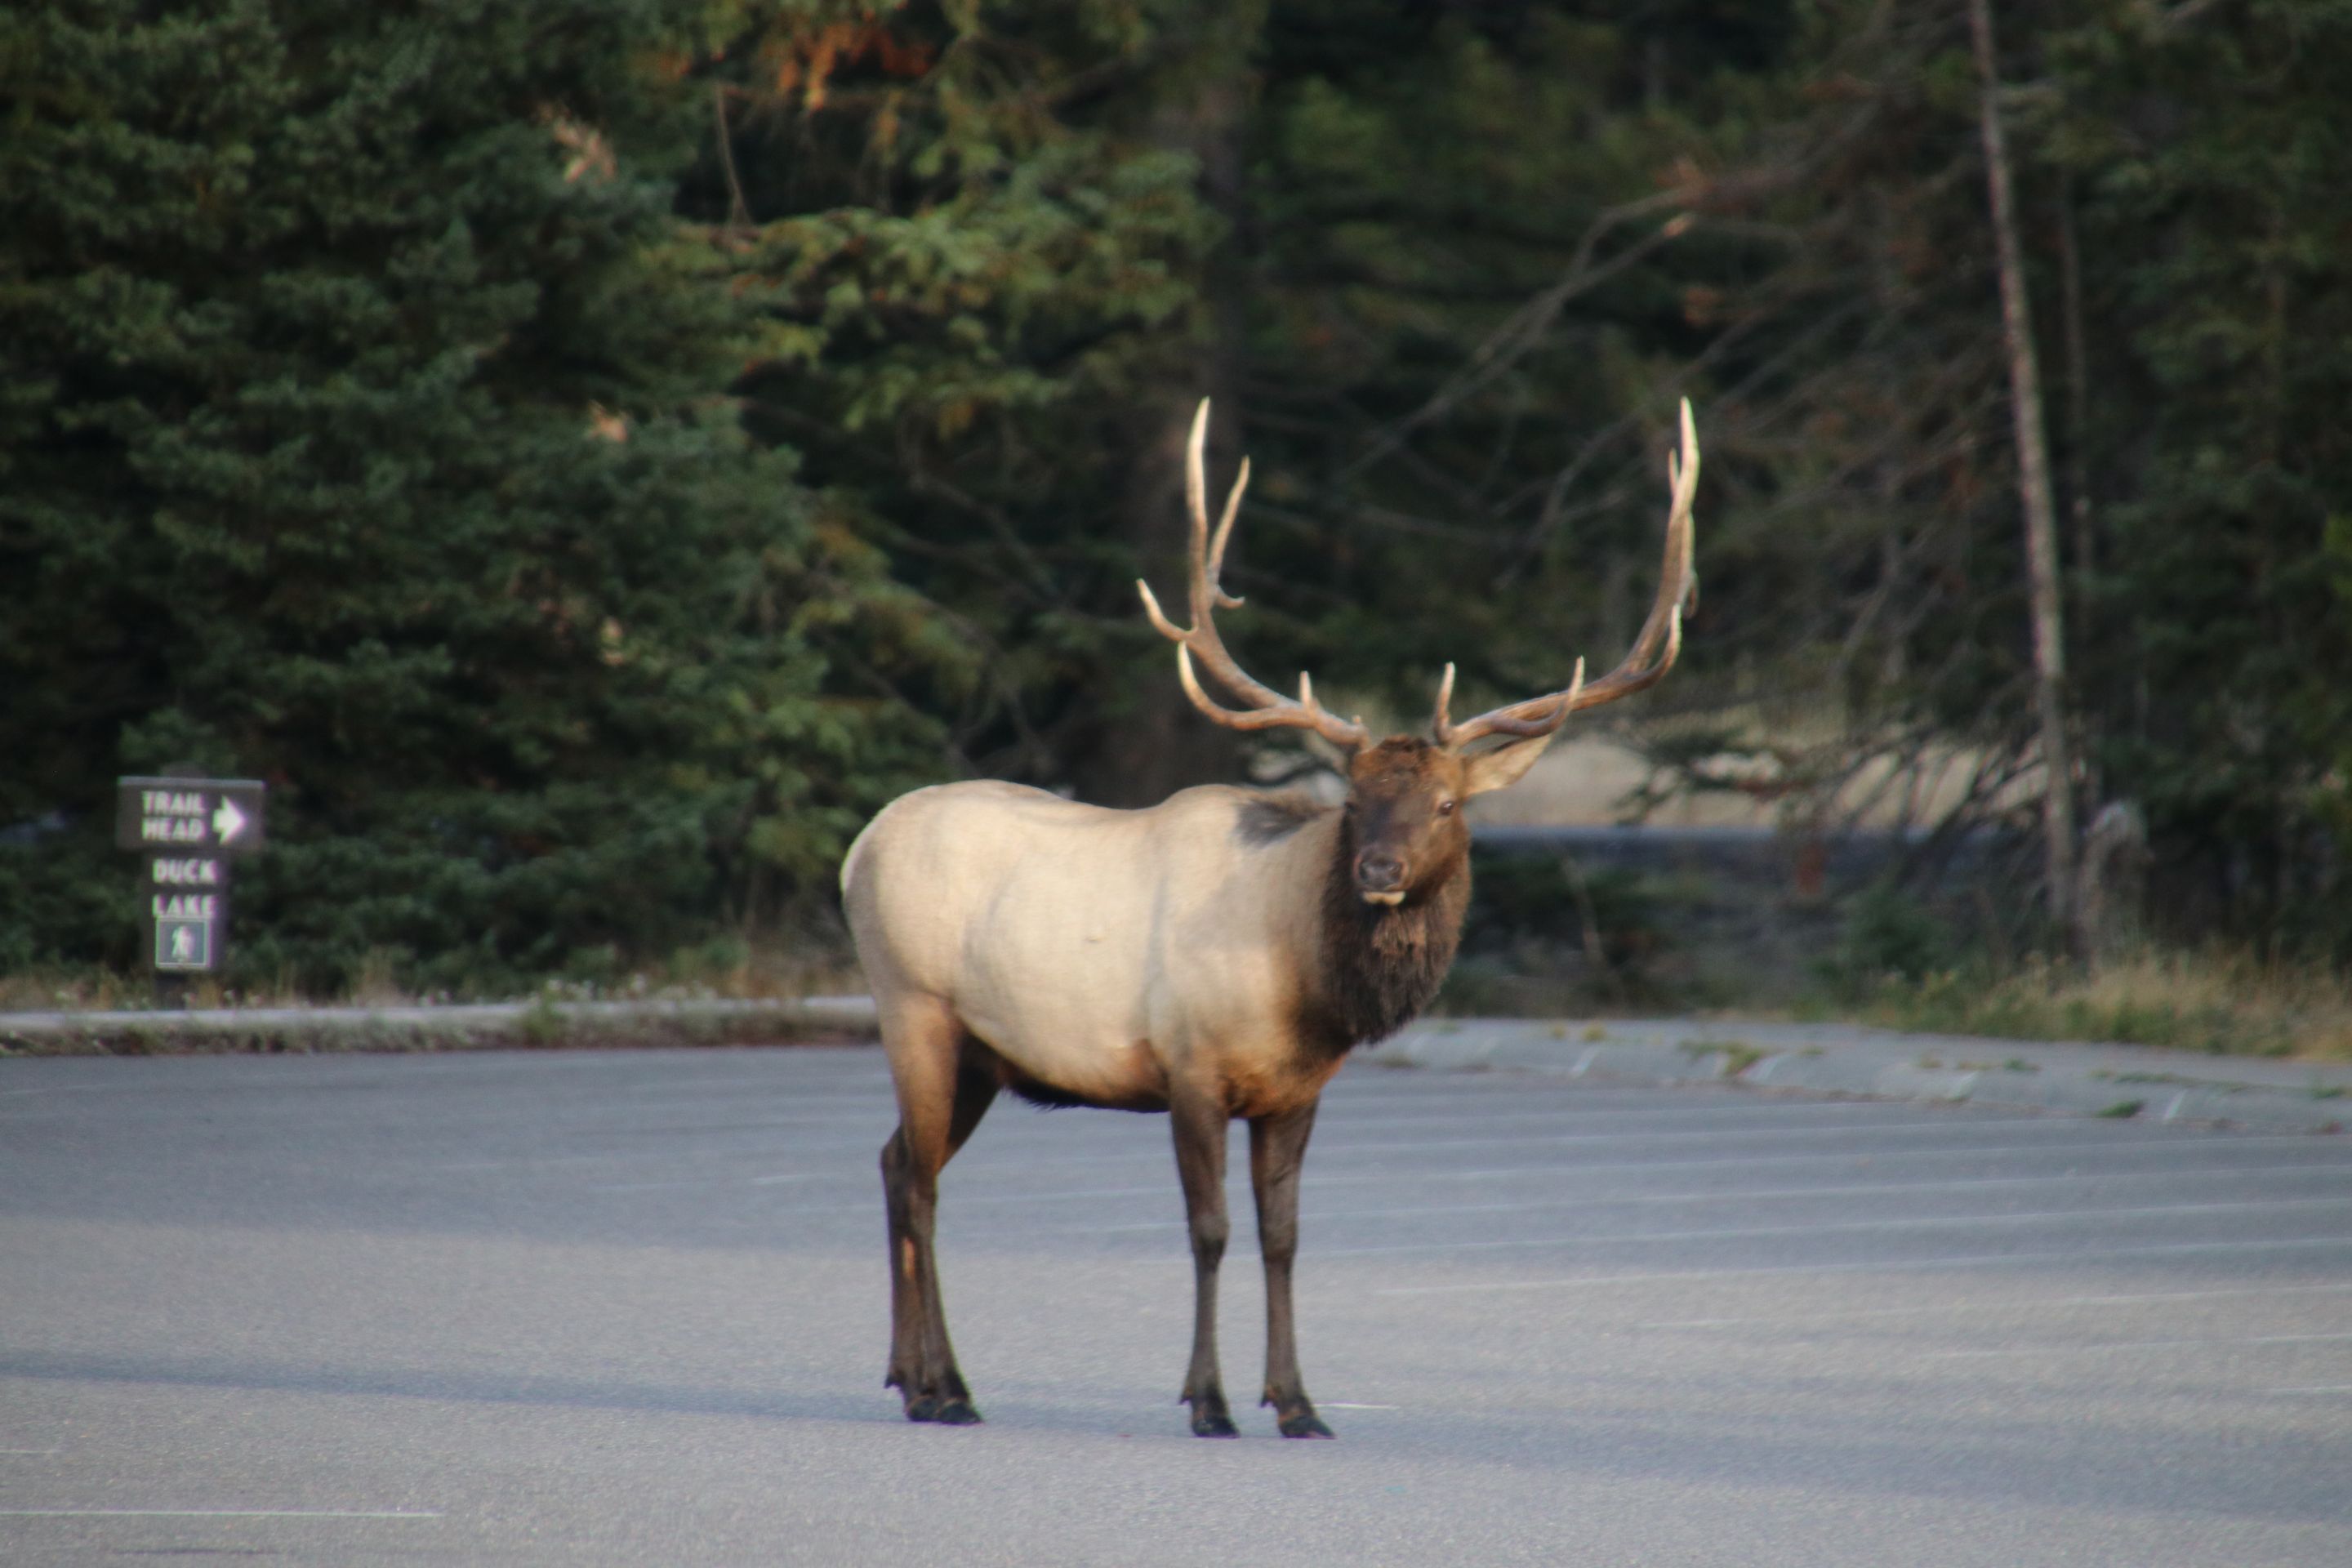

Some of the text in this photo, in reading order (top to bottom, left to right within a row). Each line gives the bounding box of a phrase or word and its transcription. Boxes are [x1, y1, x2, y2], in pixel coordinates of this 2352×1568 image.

[142, 791, 205, 814] TRAIL
[142, 817, 206, 840] HEAD
[153, 860, 216, 884] DUCK
[152, 895, 216, 917] LAKE
